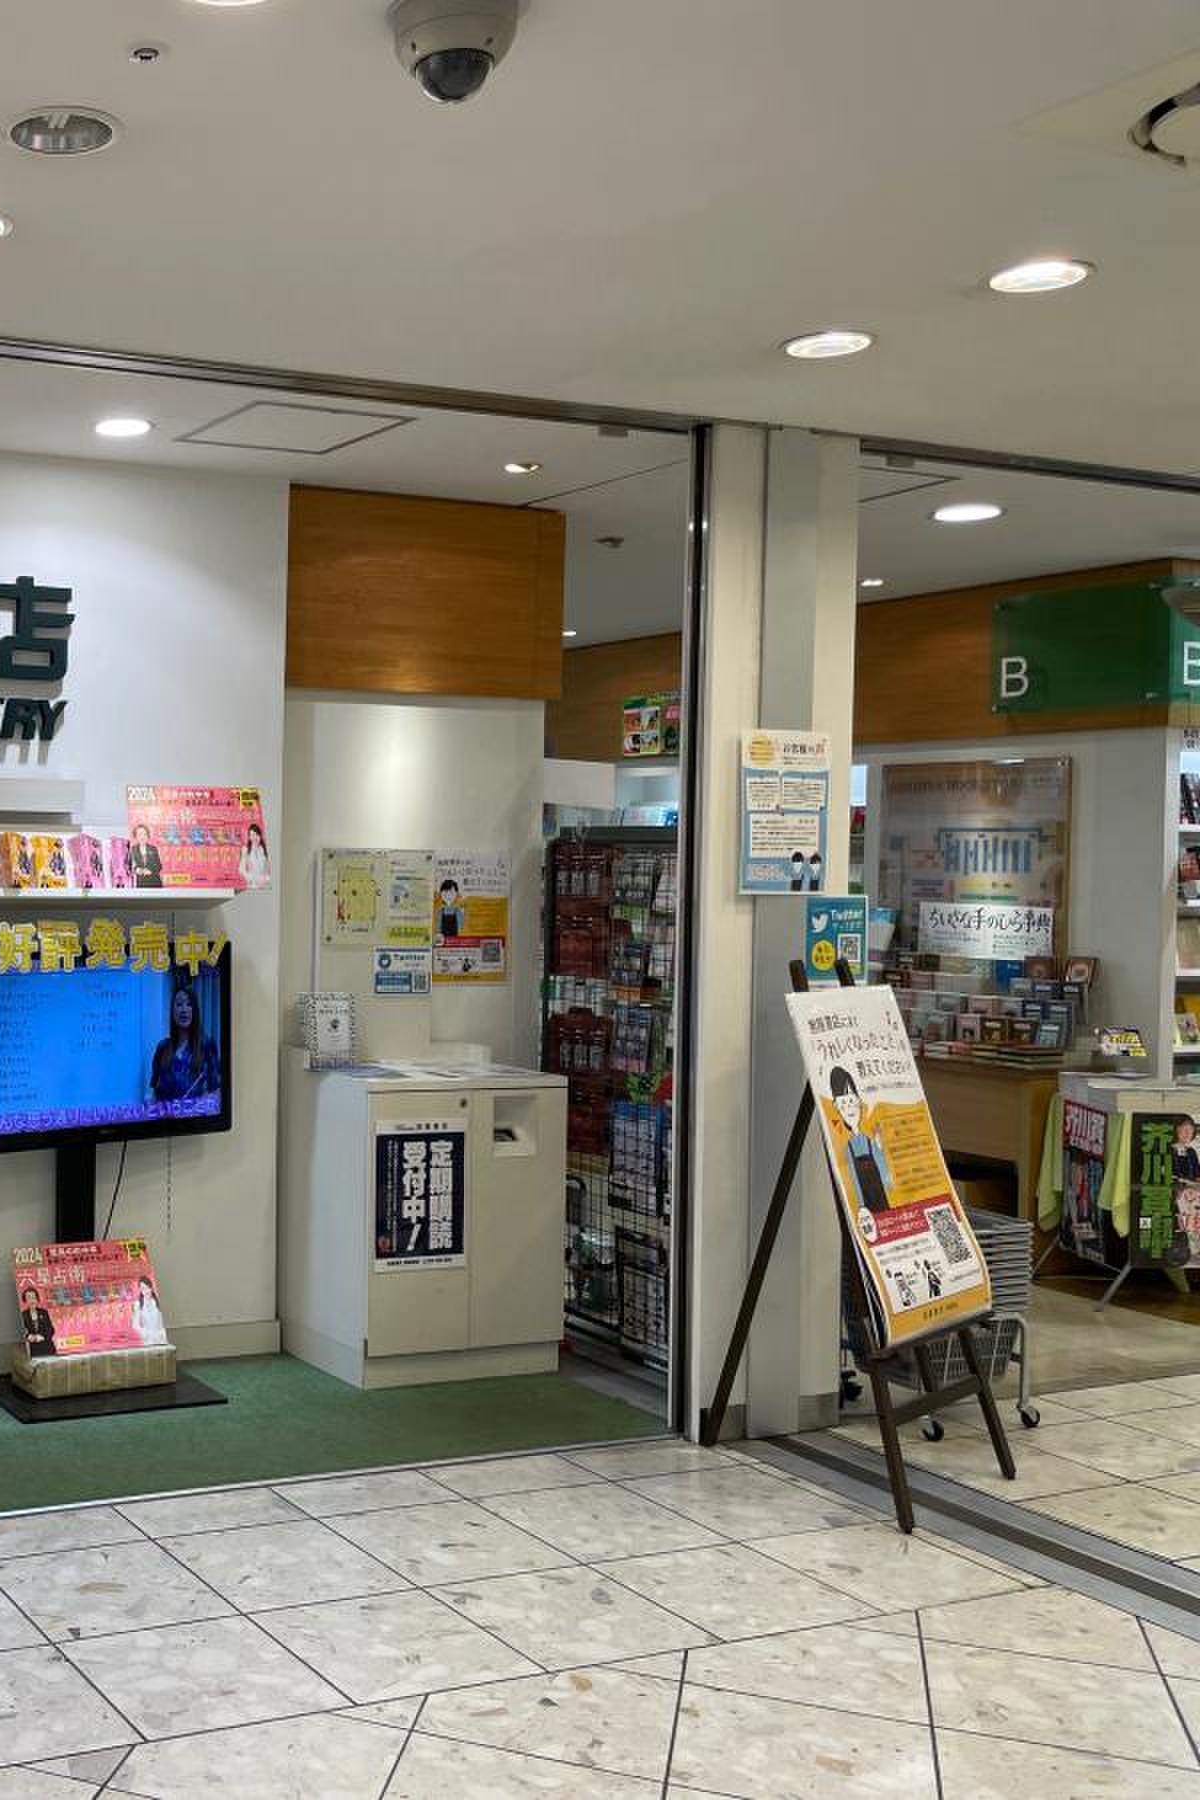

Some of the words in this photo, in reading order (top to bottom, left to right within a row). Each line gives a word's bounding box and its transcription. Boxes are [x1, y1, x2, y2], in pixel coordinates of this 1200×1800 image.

[1000, 656, 1030, 699] B
[429, 1139, 454, 1249] 定期購読
